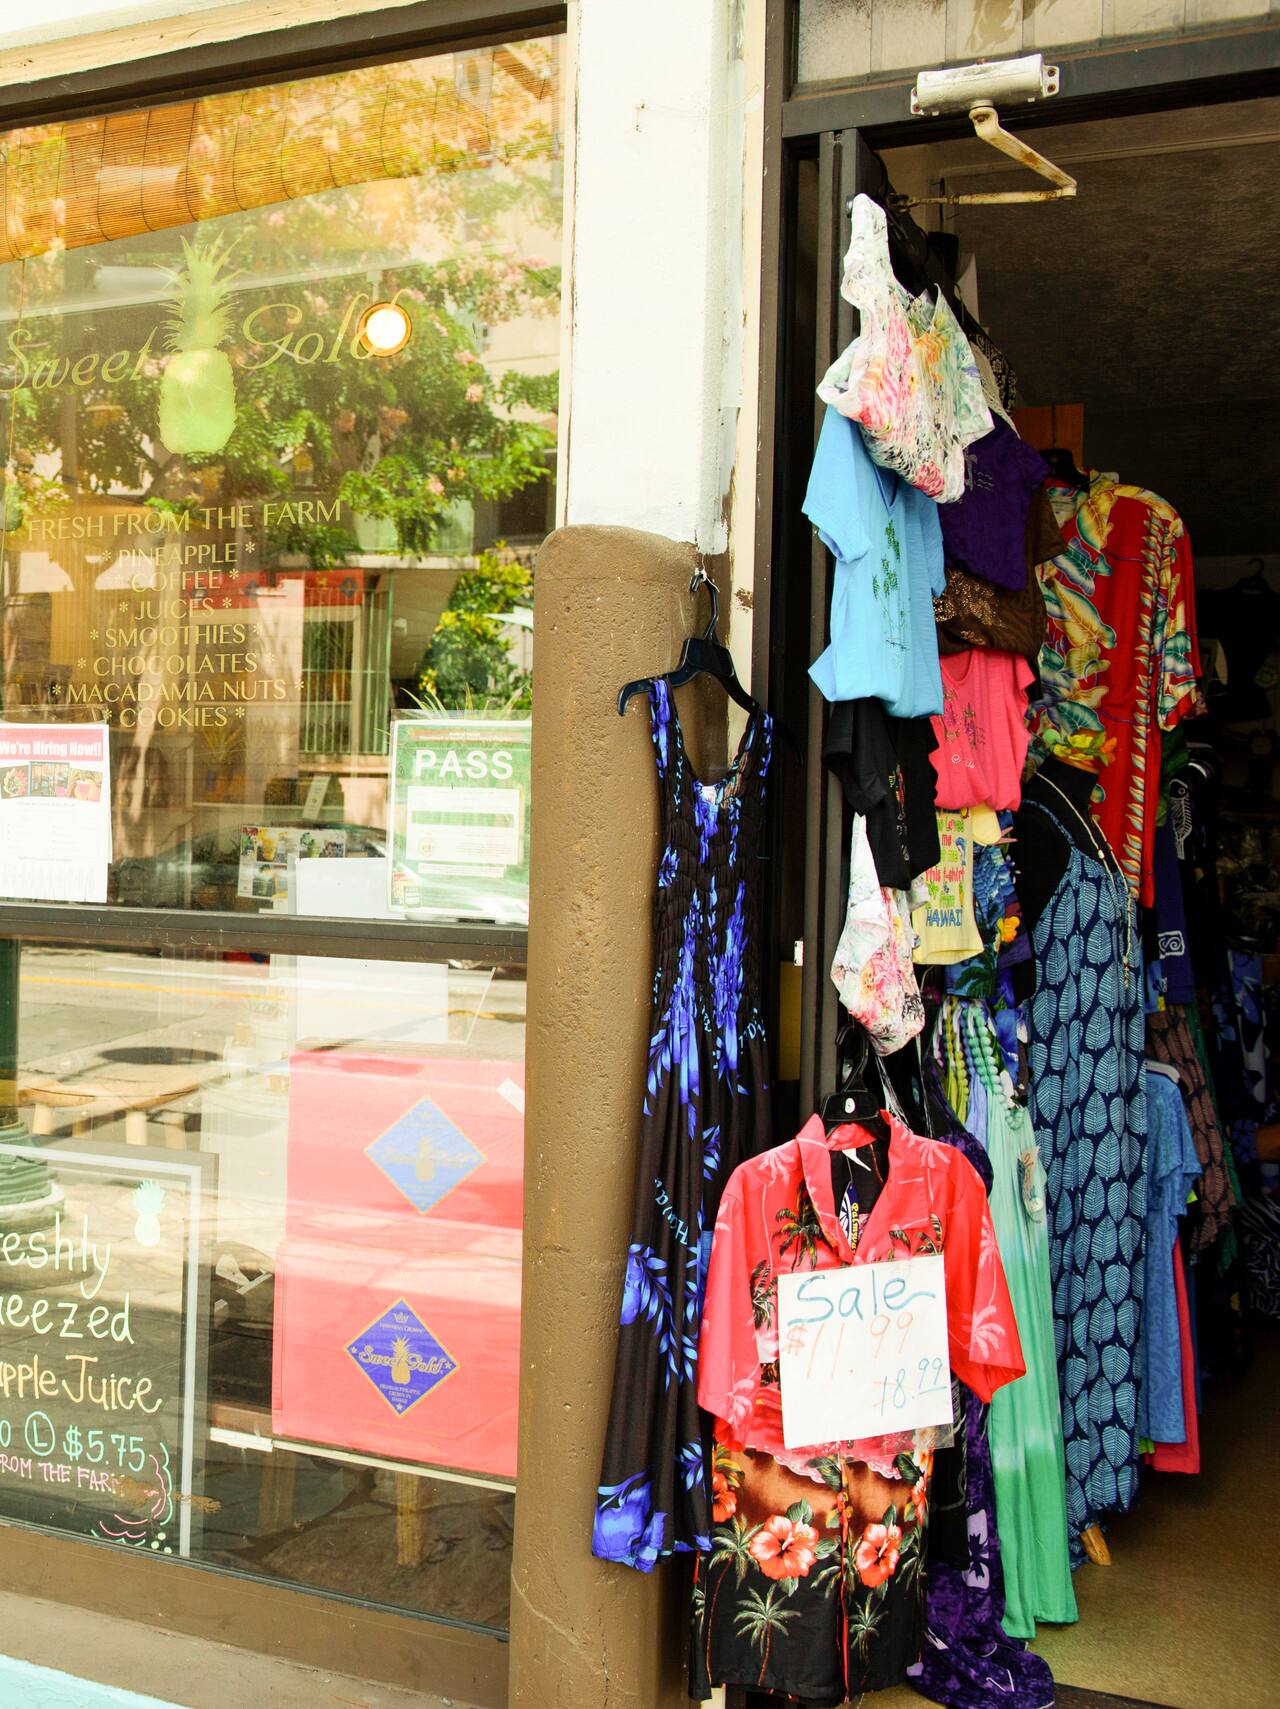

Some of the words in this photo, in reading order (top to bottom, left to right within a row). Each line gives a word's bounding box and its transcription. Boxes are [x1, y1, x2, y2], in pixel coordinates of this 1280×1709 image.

[28, 516, 103, 542] FRESH
[113, 511, 189, 536] FROM
[199, 505, 253, 530] THE
[264, 499, 341, 525] FARM
[119, 543, 238, 567] PINEAPPLE
[131, 569, 222, 593] COFFEE
[135, 598, 215, 620] JUICES
[105, 624, 246, 648] SMOOTHIES
[93, 653, 258, 677] CHOCOLATES
[69, 682, 215, 703] MACADAMIA
[223, 679, 287, 700] NUTS
[120, 707, 228, 728] COOKIES
[0, 741, 32, 755] We're
[33, 741, 68, 757] Hiring
[70, 742, 102, 756] Now!!
[415, 749, 513, 779] PASS
[787, 1269, 936, 1327] Sale
[784, 1311, 915, 1380] $11.99
[358, 1345, 403, 1367] Sweet
[407, 1353, 446, 1375] Gold
[61, 1354, 163, 1413] Juice
[62, 1424, 146, 1472] $5.75
[37, 1461, 72, 1482] THE
